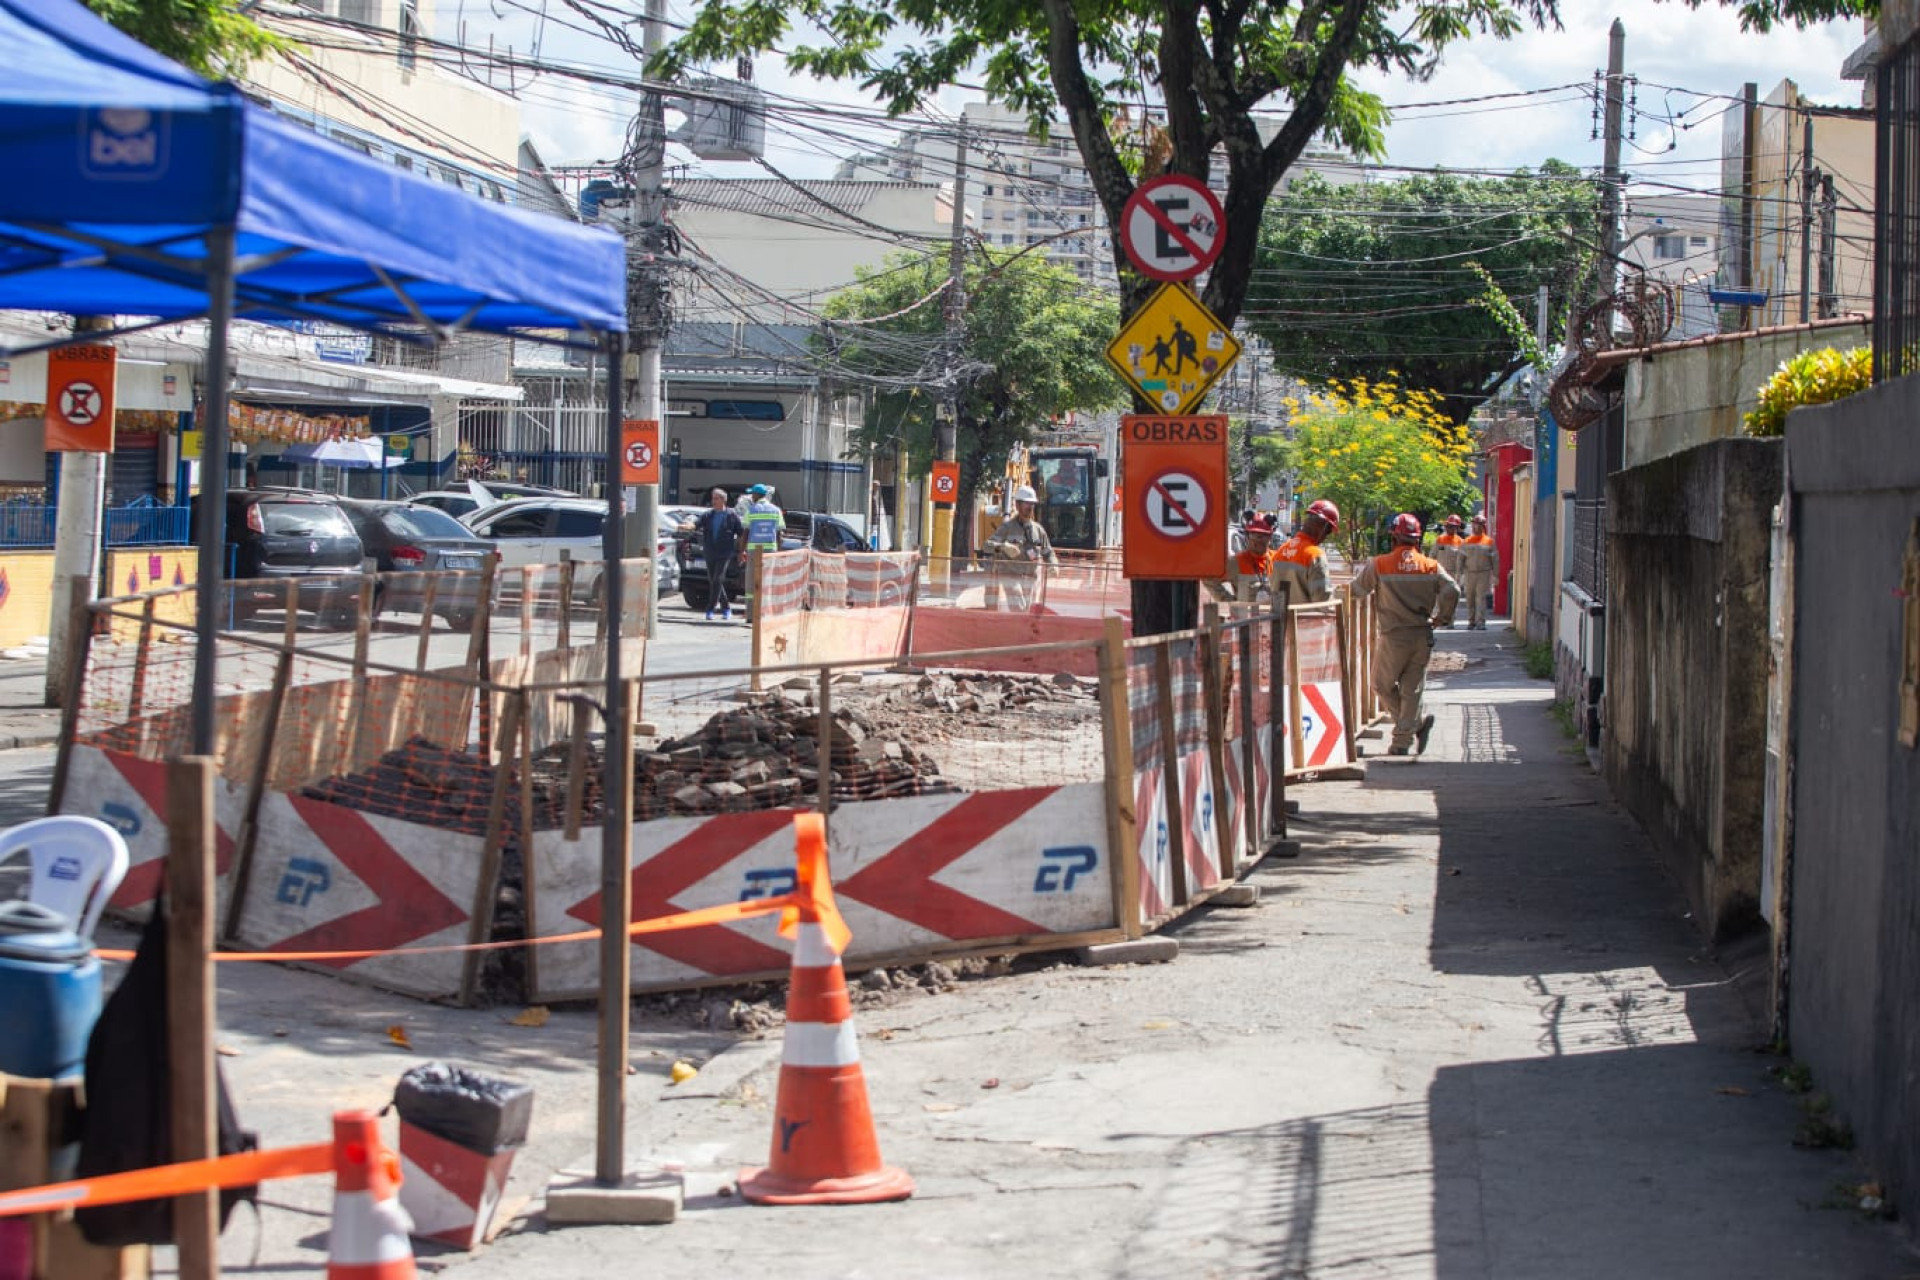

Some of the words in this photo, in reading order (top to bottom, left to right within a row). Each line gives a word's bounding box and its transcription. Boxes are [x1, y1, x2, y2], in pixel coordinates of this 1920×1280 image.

[1133, 422, 1217, 440] OBRAS
[1162, 483, 1189, 526] E
[277, 858, 330, 907] EP
[1033, 846, 1098, 892] EP
